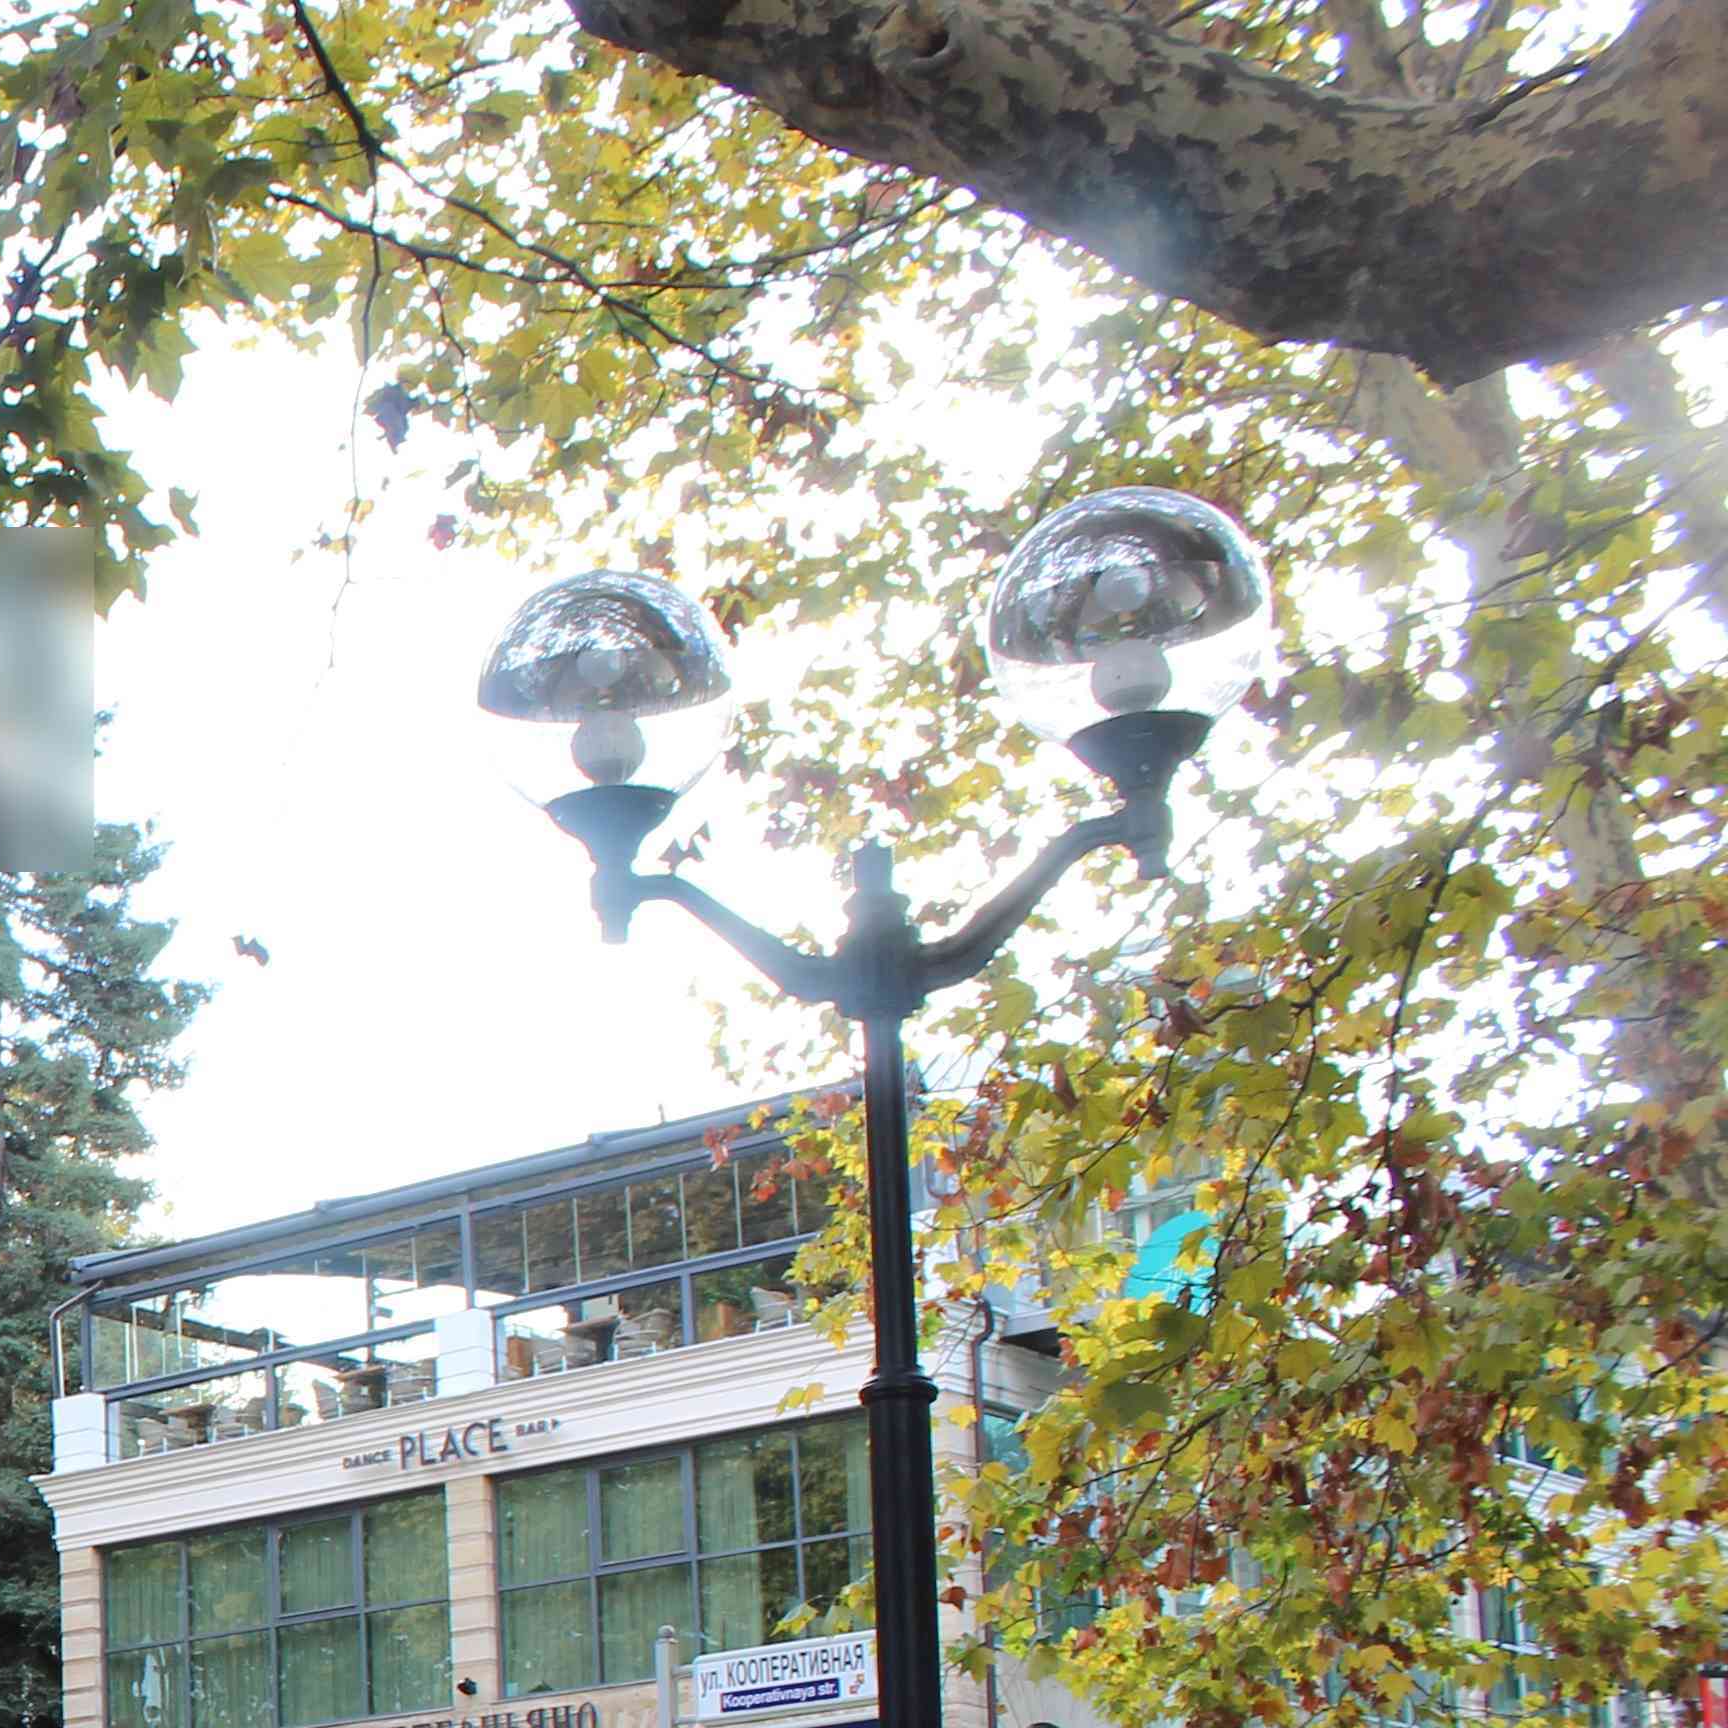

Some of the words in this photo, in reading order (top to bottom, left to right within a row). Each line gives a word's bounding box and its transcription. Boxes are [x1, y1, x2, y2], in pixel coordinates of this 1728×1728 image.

[399, 1417, 508, 1470] PLACE
[700, 1672, 722, 1697] ул.
[726, 1643, 865, 1687] КООПЕРАТИВНАЯ
[723, 1686, 816, 1709] Kooperativnaya
[818, 1682, 838, 1697] str.
